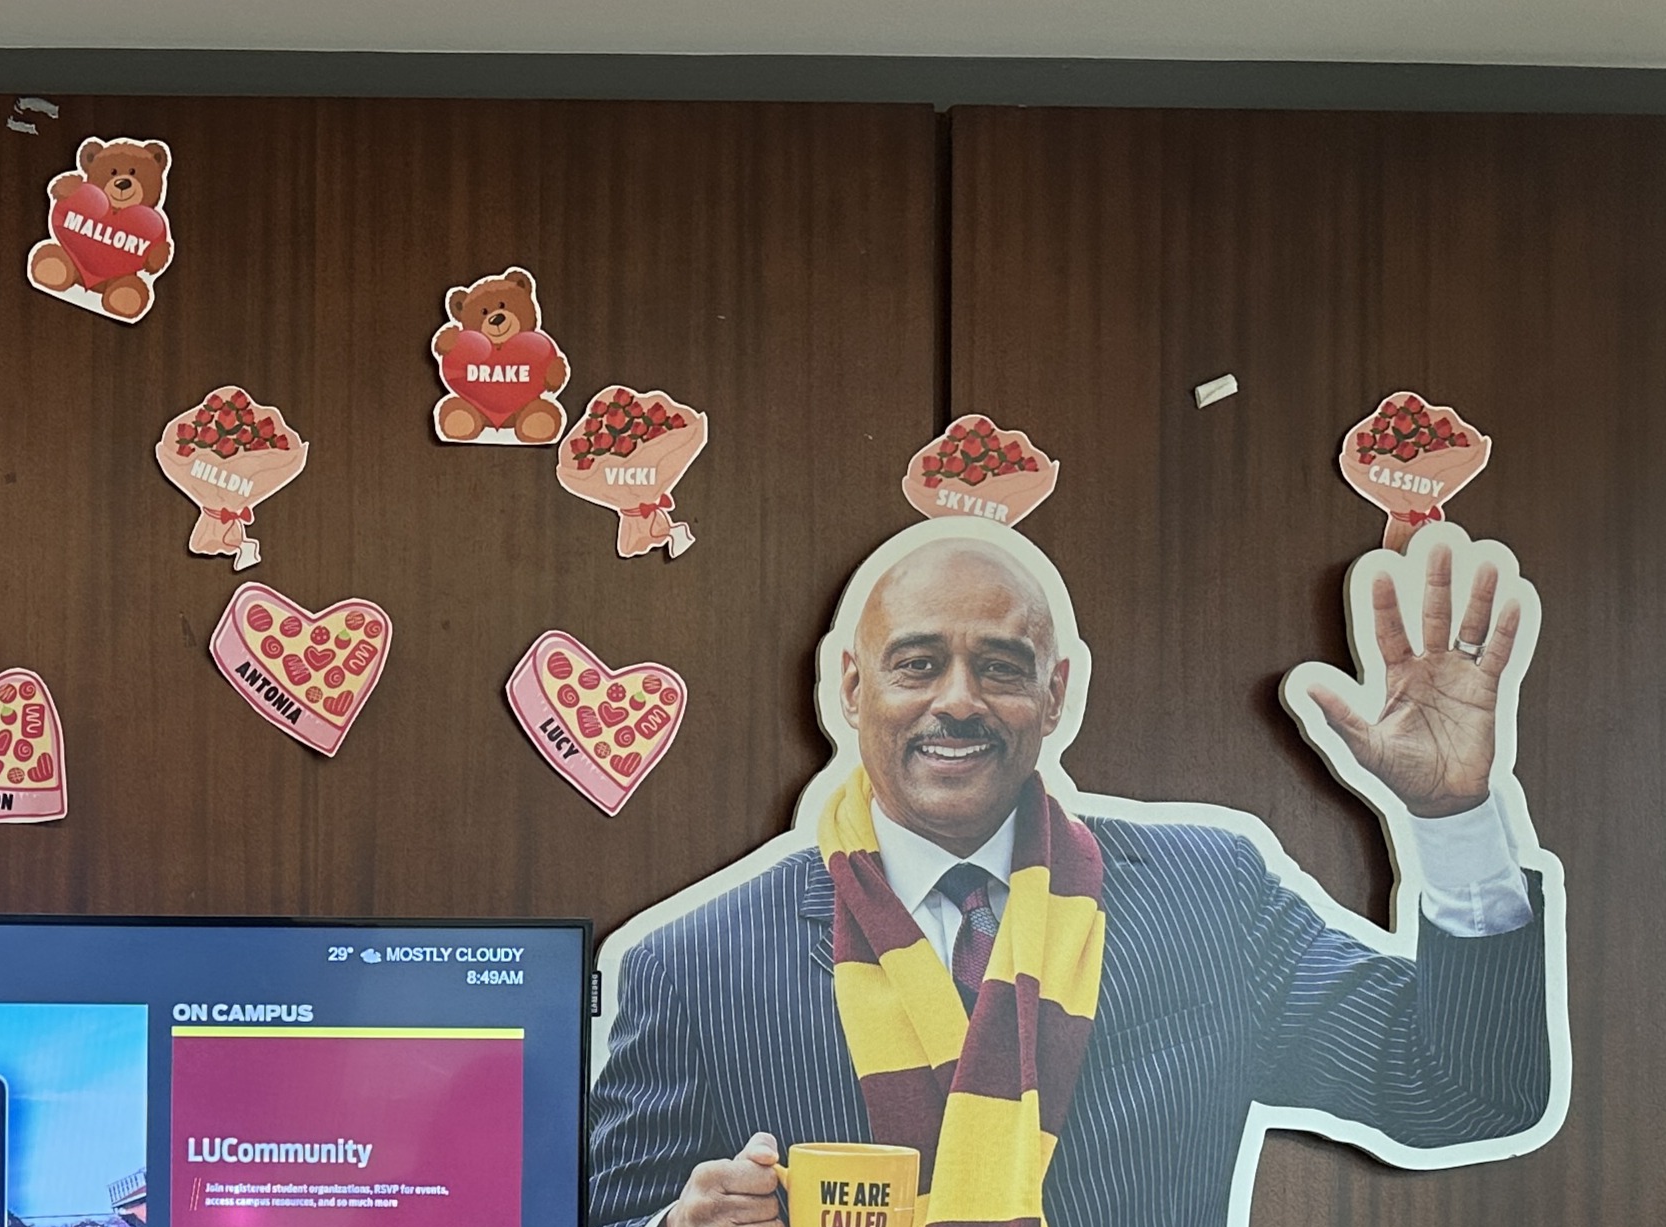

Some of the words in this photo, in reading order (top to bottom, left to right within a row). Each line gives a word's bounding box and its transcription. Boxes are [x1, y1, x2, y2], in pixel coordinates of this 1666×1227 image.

[63, 211, 152, 256] MALLORY
[466, 364, 530, 384] DRAKE
[604, 466, 655, 486] VICKI
[1369, 464, 1444, 499] CASSIDY
[936, 489, 1009, 522] SKYLER
[235, 662, 303, 724] ANTONIA
[539, 717, 580, 761] LUCY
[328, 947, 354, 961] 29°
[386, 947, 452, 962] MOSTLY
[456, 948, 524, 962] CLOUDY
[466, 970, 524, 985] 8:49AM
[172, 1004, 207, 1021] ON
[212, 1004, 314, 1022] CAMPUS
[188, 1137, 372, 1168] LUCommunity
[205, 1183, 223, 1193] Join
[225, 1183, 271, 1196] registered
[272, 1184, 307, 1194] student
[309, 1184, 373, 1196] organizations,
[374, 1185, 399, 1194] RSVP
[401, 1184, 414, 1194] for
[415, 1186, 449, 1196] events,
[820, 1181, 849, 1206] WE
[853, 1182, 891, 1207] ARE
[205, 1198, 234, 1206] access
[235, 1198, 270, 1208] campus
[272, 1198, 317, 1208] resources,
[318, 1197, 335, 1207] and
[337, 1199, 347, 1207] so
[349, 1197, 373, 1207] much
[375, 1199, 398, 1207] more
